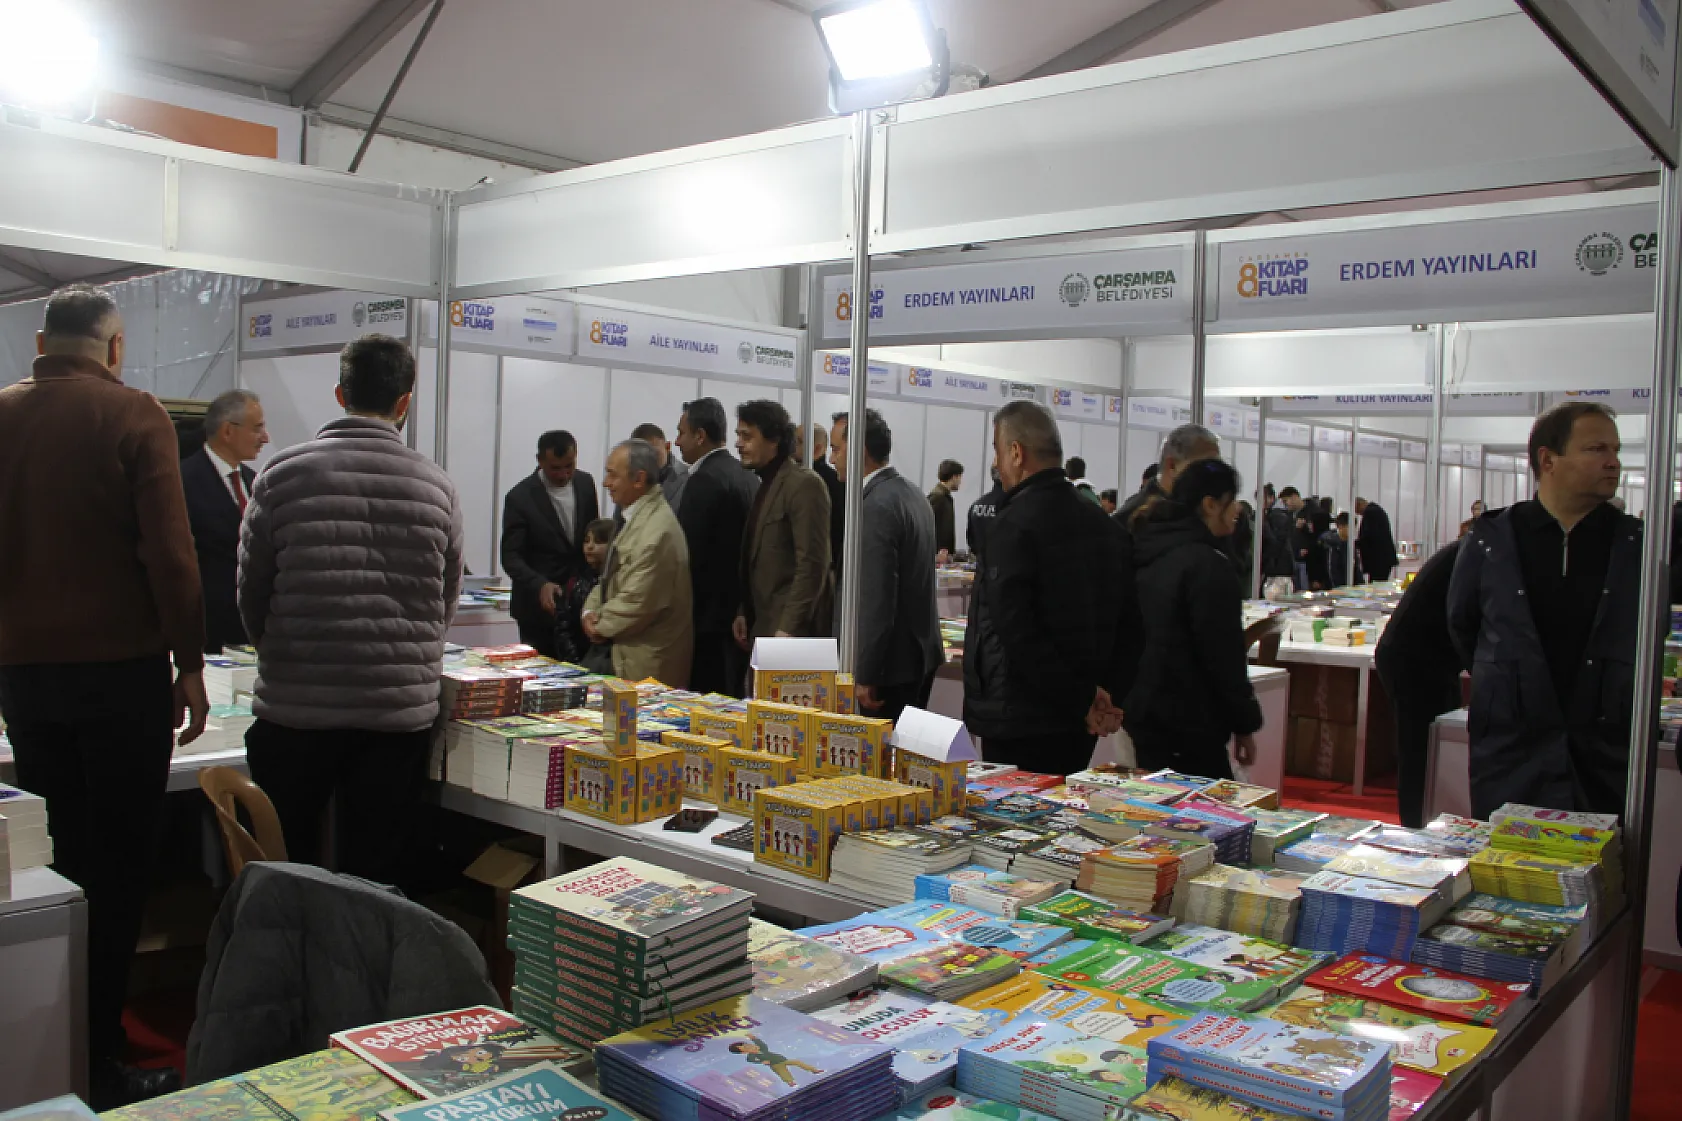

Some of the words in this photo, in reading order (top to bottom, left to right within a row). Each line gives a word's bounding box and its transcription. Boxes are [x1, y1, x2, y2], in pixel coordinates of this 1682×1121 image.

[1339, 258, 1416, 282] ERDEM
[1423, 250, 1538, 275] YAYINLARI
[1093, 269, 1177, 290] ÇARŞAMBA
[1257, 277, 1308, 297] FUARI
[903, 291, 955, 308] ERDEM
[958, 285, 1036, 305] YAYINLARI
[1096, 286, 1174, 303] BELEDİYESİ
[649, 333, 671, 349] AİLE
[672, 338, 719, 355] YAYINLARI
[860, 1007, 938, 1040] OLCULUK
[422, 1082, 552, 1121] PASTAYI
